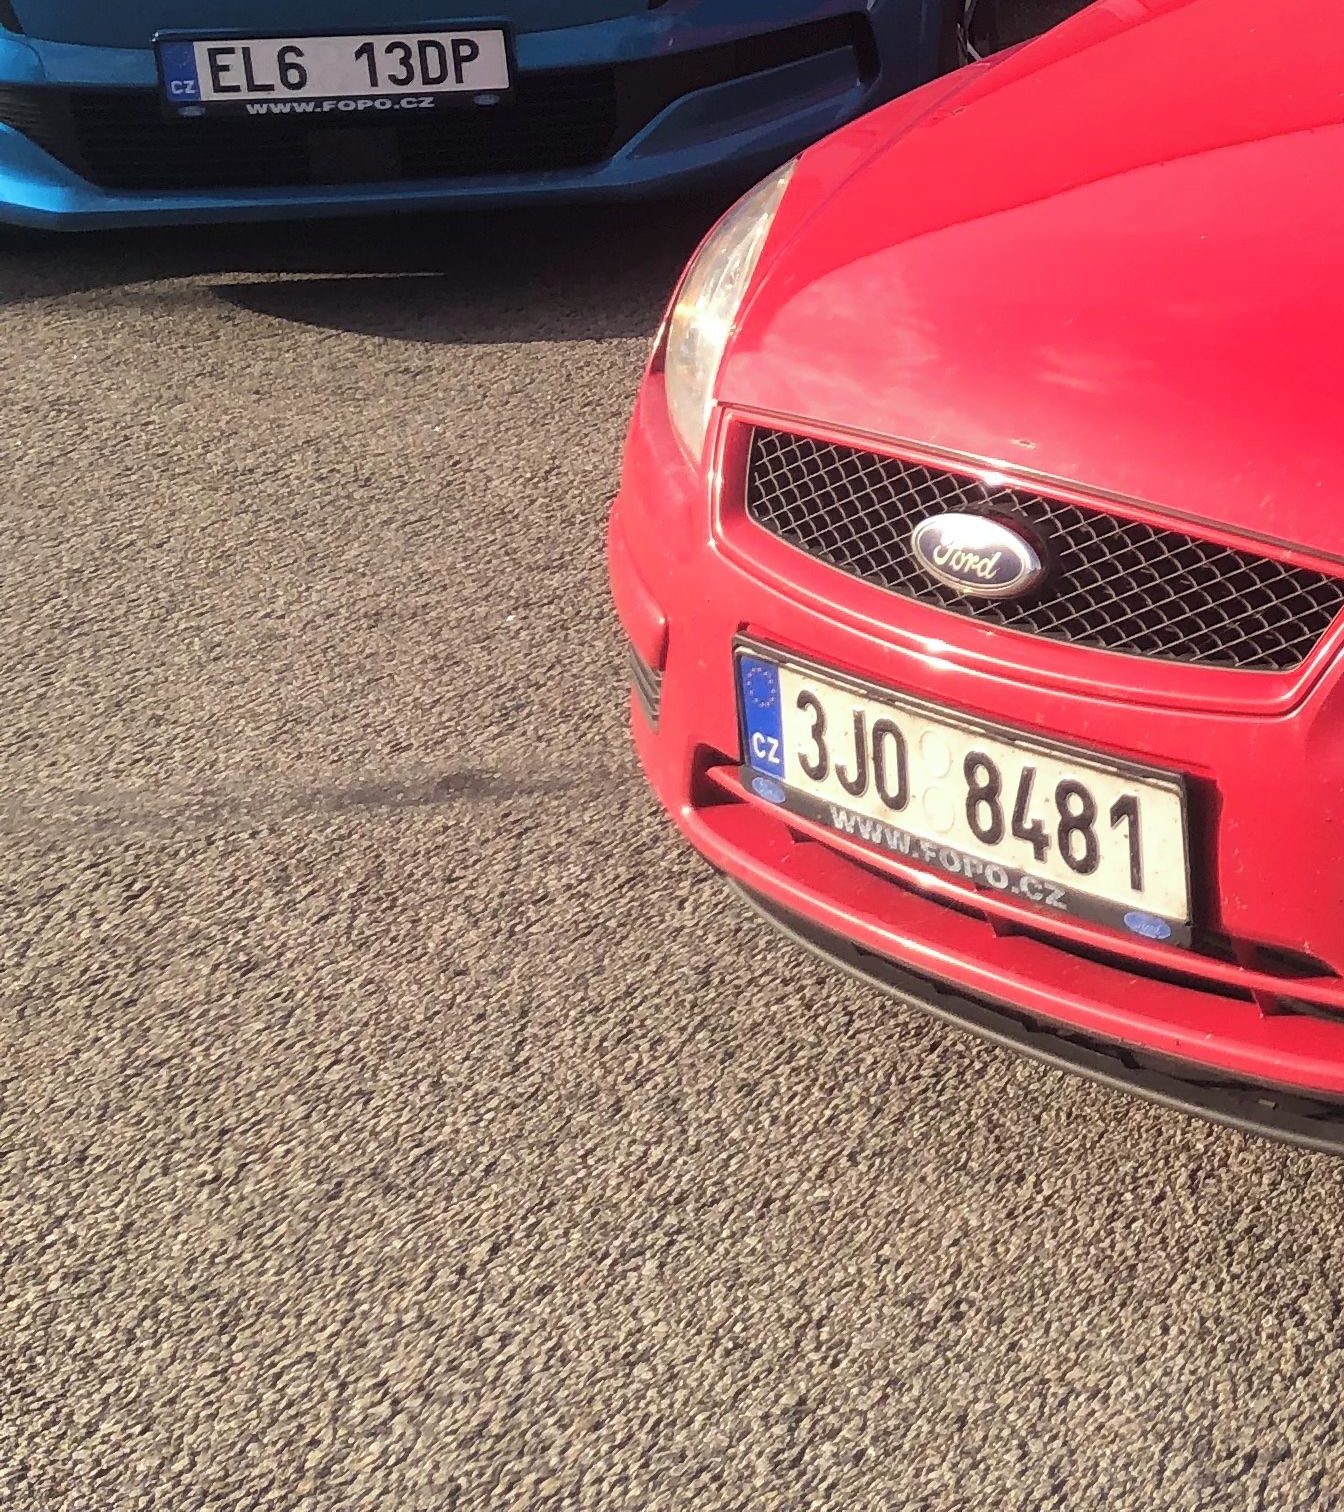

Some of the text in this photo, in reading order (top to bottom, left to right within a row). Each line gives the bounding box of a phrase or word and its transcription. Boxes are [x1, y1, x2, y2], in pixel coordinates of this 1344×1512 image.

[206, 38, 480, 93] EL6 13DP
[170, 78, 196, 95] CZ
[246, 95, 435, 115] WWW.FOPO.CZ
[752, 731, 781, 765] CZ
[796, 688, 1145, 894] 3J0 8481
